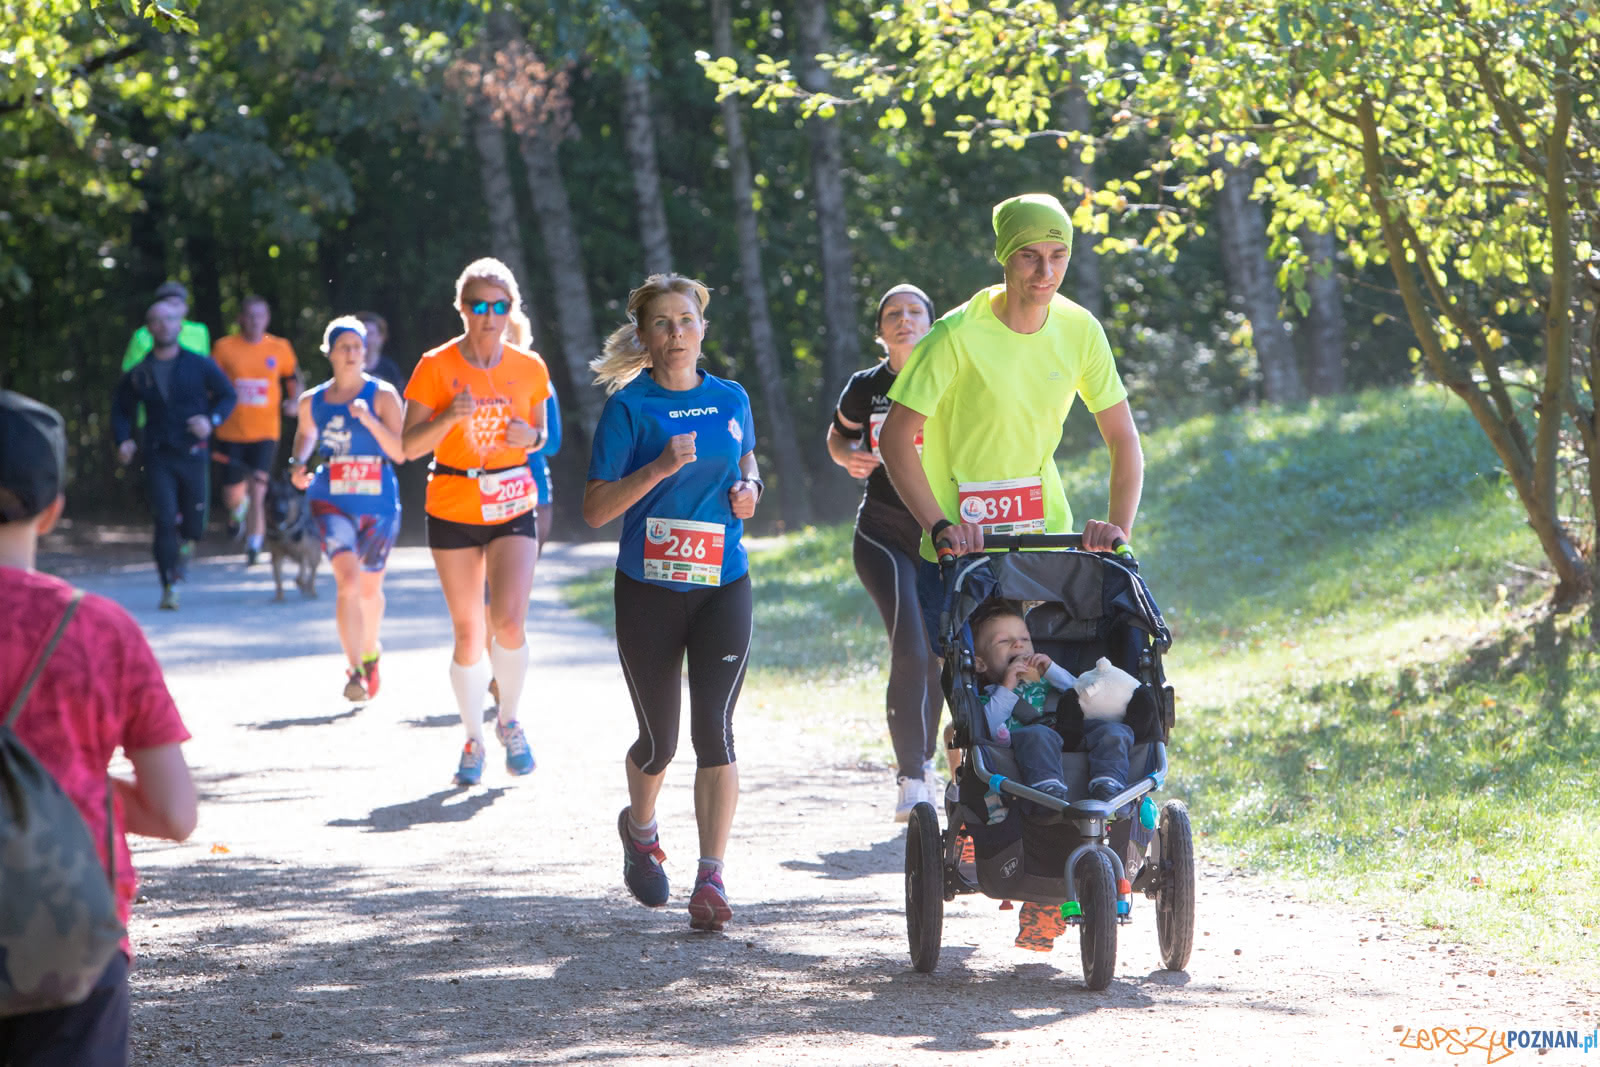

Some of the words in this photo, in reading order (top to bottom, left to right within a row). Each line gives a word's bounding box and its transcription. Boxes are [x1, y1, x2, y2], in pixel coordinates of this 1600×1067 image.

[669, 407, 718, 418] GIVOVA
[496, 480, 525, 501] 202
[984, 496, 1022, 519] 391
[664, 536, 706, 560] 266
